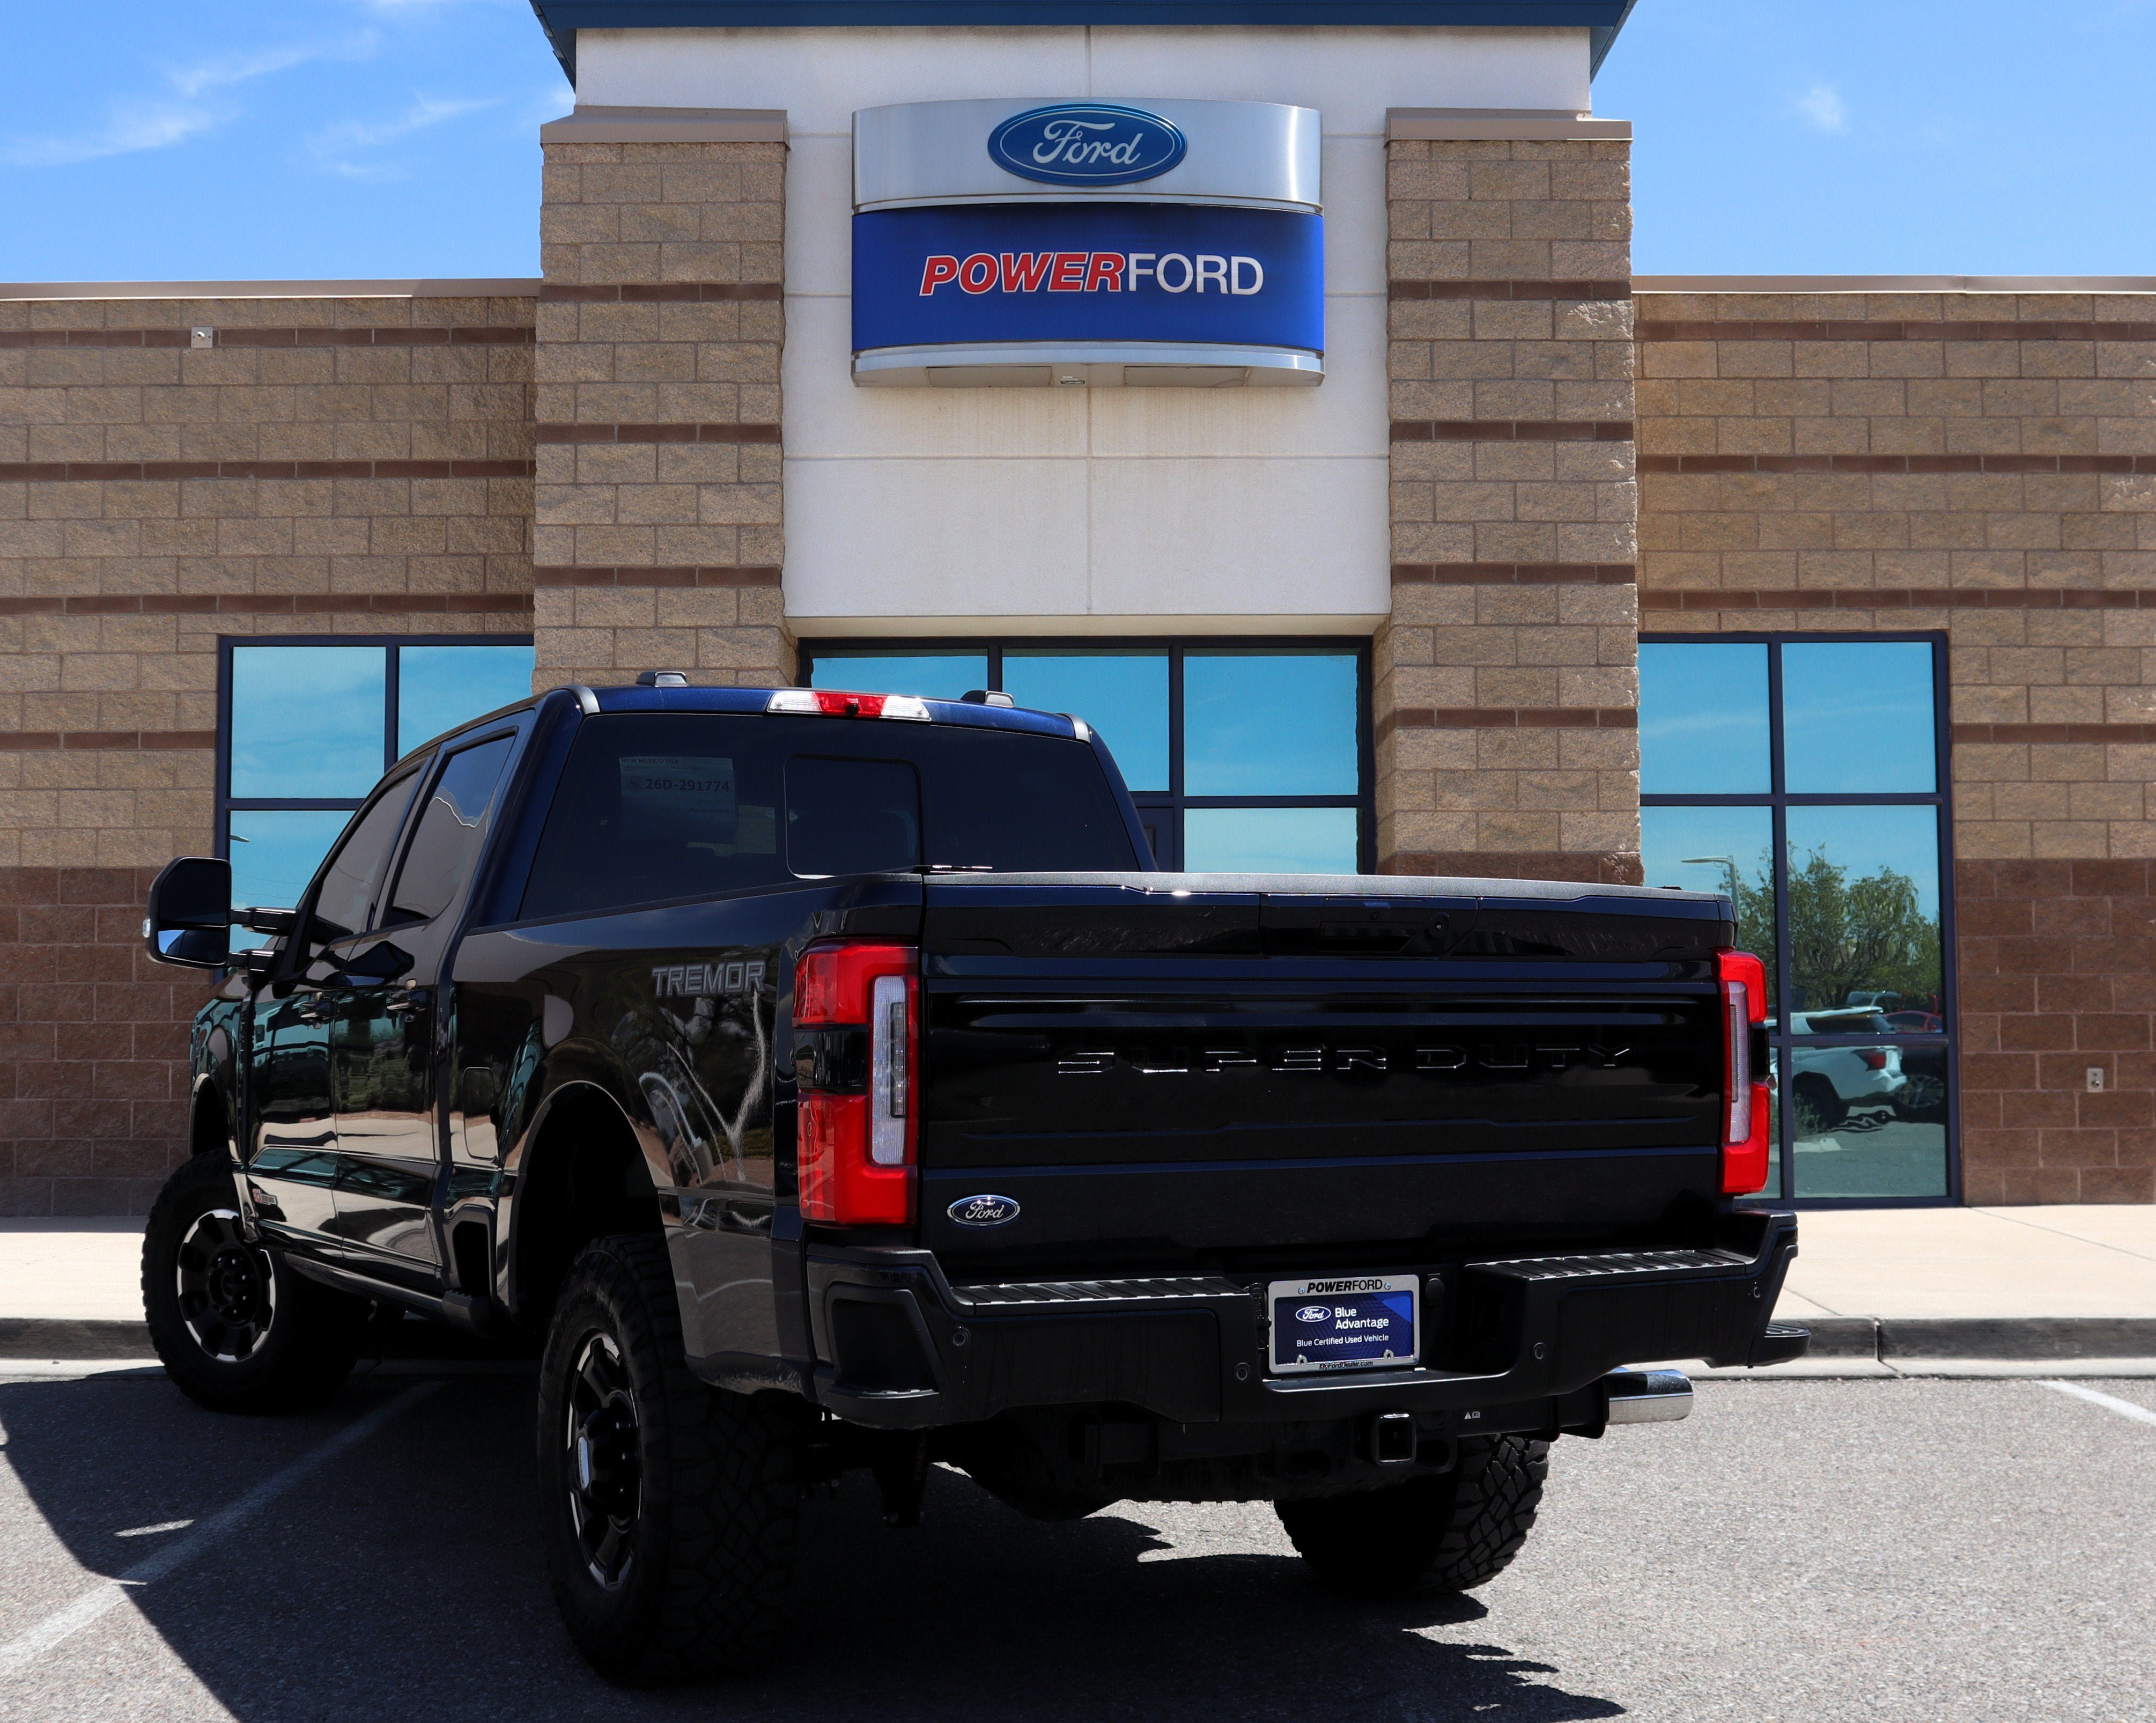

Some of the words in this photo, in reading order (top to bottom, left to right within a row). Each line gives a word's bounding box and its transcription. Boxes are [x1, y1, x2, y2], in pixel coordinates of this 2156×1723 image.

[1032, 119, 1143, 165] Ford
[919, 251, 1265, 296] POWERFORD
[645, 778, 730, 792] 26D-291774
[652, 960, 766, 998] TREMOR
[1057, 1045, 1387, 1074] SUPER
[1415, 1044, 1630, 1070] DUTY
[965, 1200, 1005, 1219] Ford
[1306, 1279, 1383, 1294] POWERFORD
[1302, 1308, 1325, 1320] Ford
[1334, 1307, 1357, 1317] Blue
[1335, 1317, 1390, 1330] Advantage
[1296, 1339, 1313, 1348] Blue
[1313, 1336, 1344, 1346] Certified
[1345, 1335, 1363, 1344] Used
[1363, 1334, 1390, 1343] Vehicle
